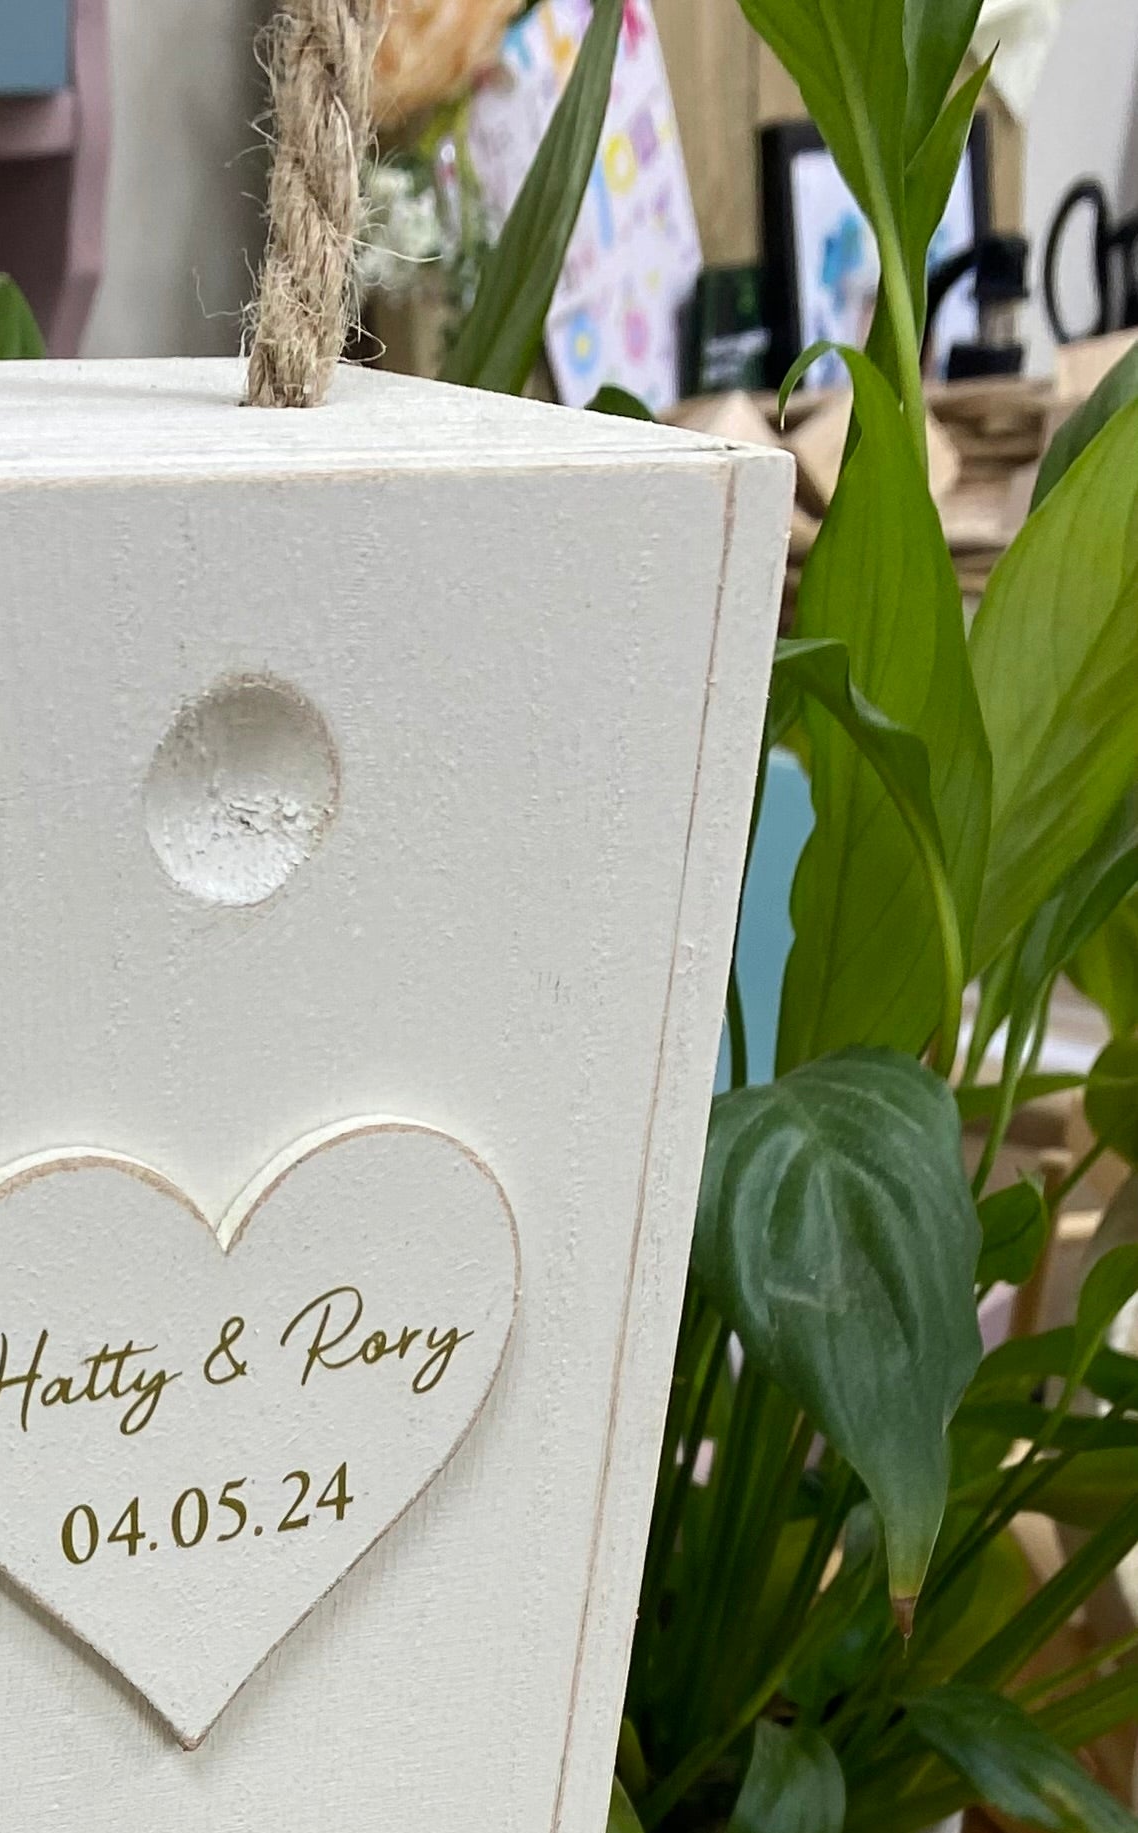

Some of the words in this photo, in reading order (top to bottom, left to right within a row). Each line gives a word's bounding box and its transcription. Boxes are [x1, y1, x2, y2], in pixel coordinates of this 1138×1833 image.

[203, 1316, 247, 1385] &
[280, 1286, 474, 1394] Rory
[61, 1461, 355, 1565] 04.05.24
